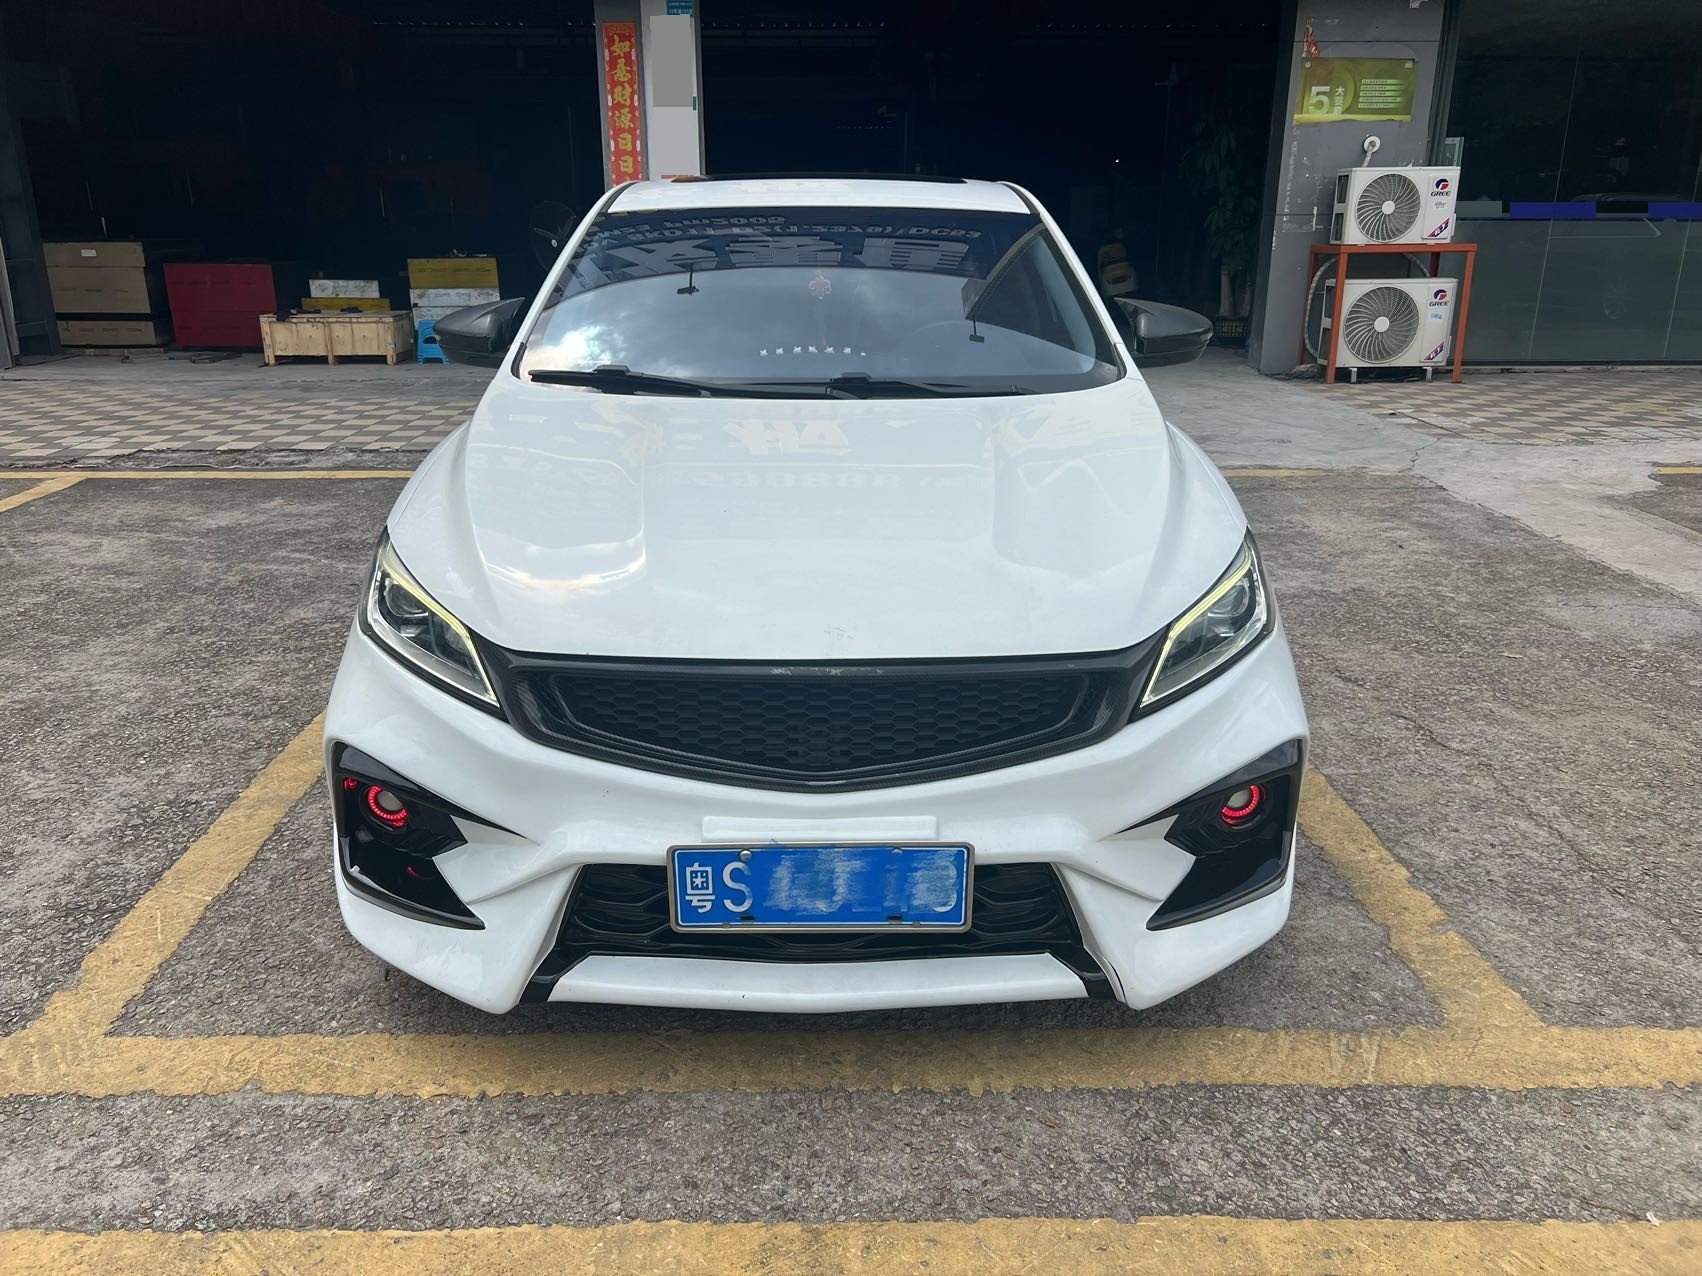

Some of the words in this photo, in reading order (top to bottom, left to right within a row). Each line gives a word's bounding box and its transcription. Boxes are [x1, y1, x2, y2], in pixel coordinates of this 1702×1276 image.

[611, 34, 635, 183] 如意财源日日
[1309, 86, 1330, 115] 5
